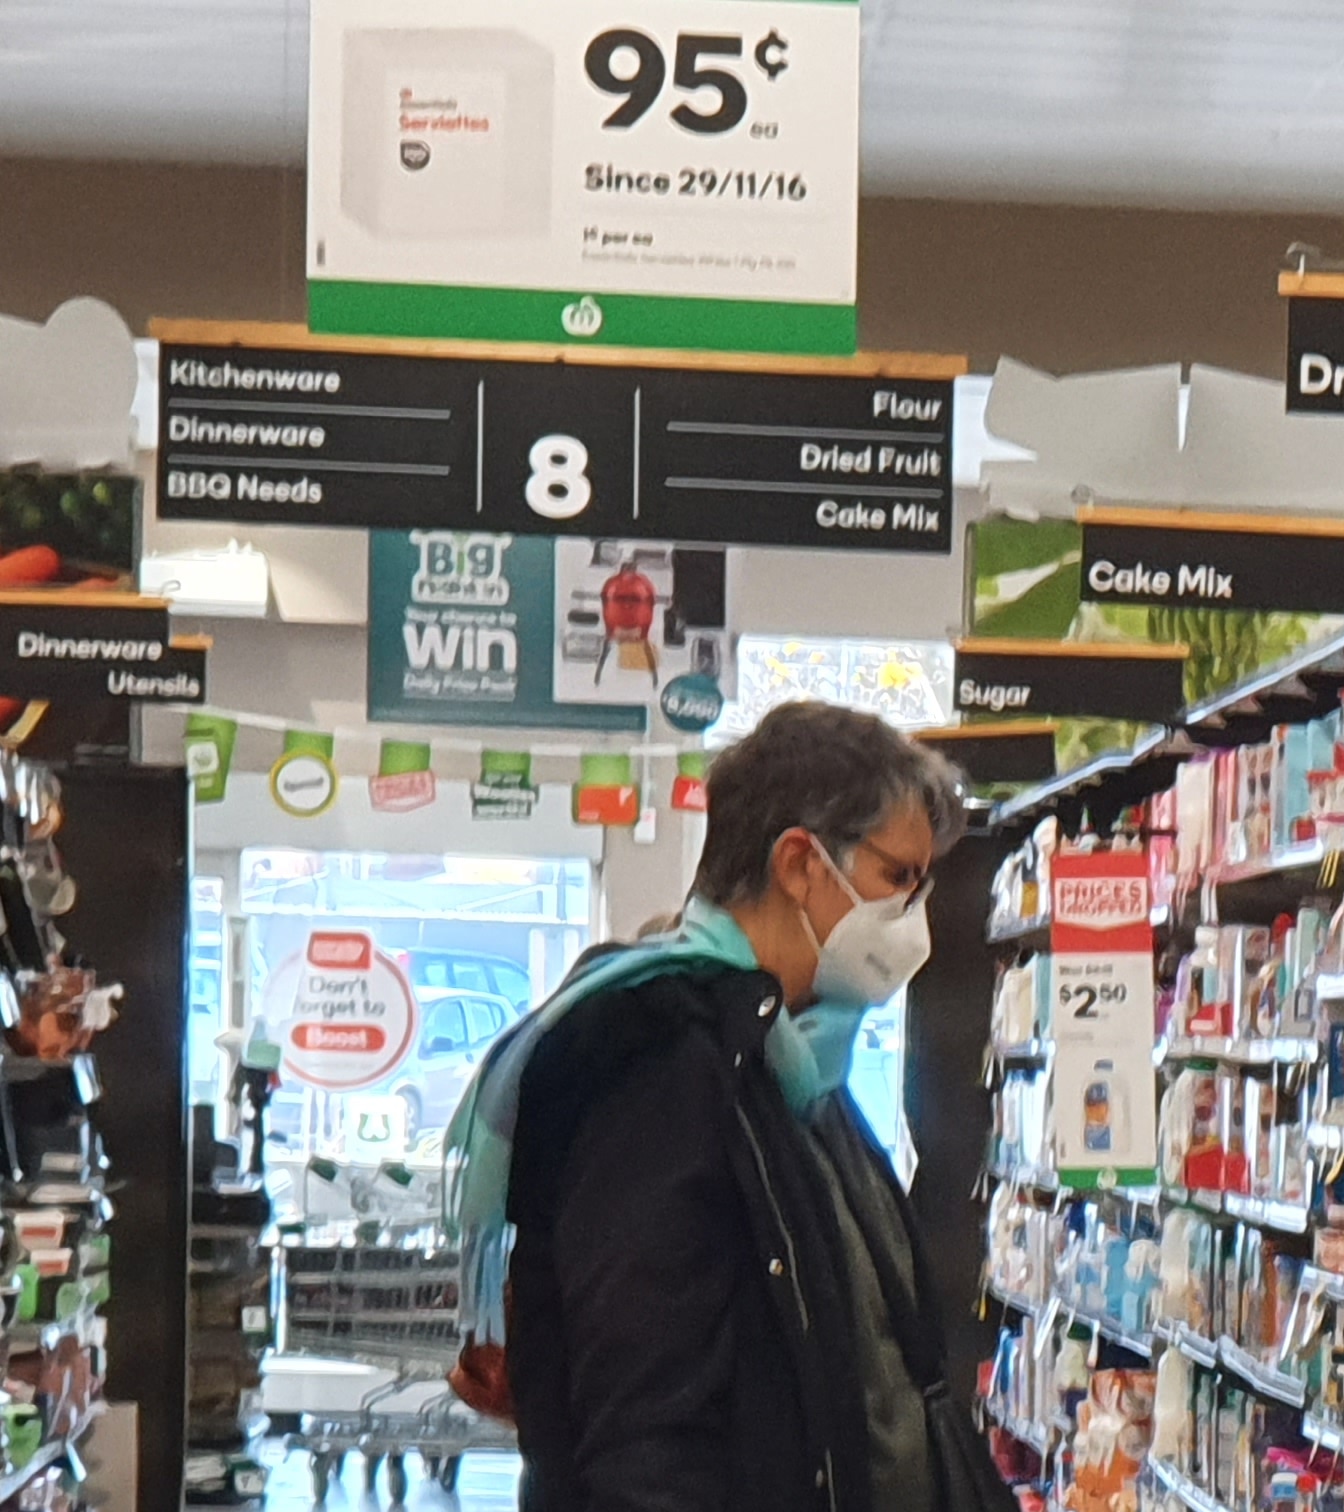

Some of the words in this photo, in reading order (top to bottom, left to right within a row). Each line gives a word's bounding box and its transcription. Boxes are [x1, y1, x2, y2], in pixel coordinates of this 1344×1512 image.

[585, 163, 670, 194] Since
[679, 168, 807, 201] 29/11/16
[170, 360, 340, 394] Kitchenware
[872, 391, 942, 423] Flour
[168, 417, 325, 448] Dinnerware
[524, 434, 591, 519] 8
[800, 444, 871, 474] Dried
[878, 446, 942, 478] Fruit
[167, 472, 232, 503] BBQ
[237, 476, 322, 506] Needs
[815, 502, 887, 531] Cake
[893, 503, 940, 534] Mix
[1088, 560, 1171, 593] Cake
[1177, 562, 1234, 597] Mix
[18, 631, 163, 662] Dinnerware
[107, 670, 200, 698] Utensils
[958, 679, 1031, 708] Sugar
